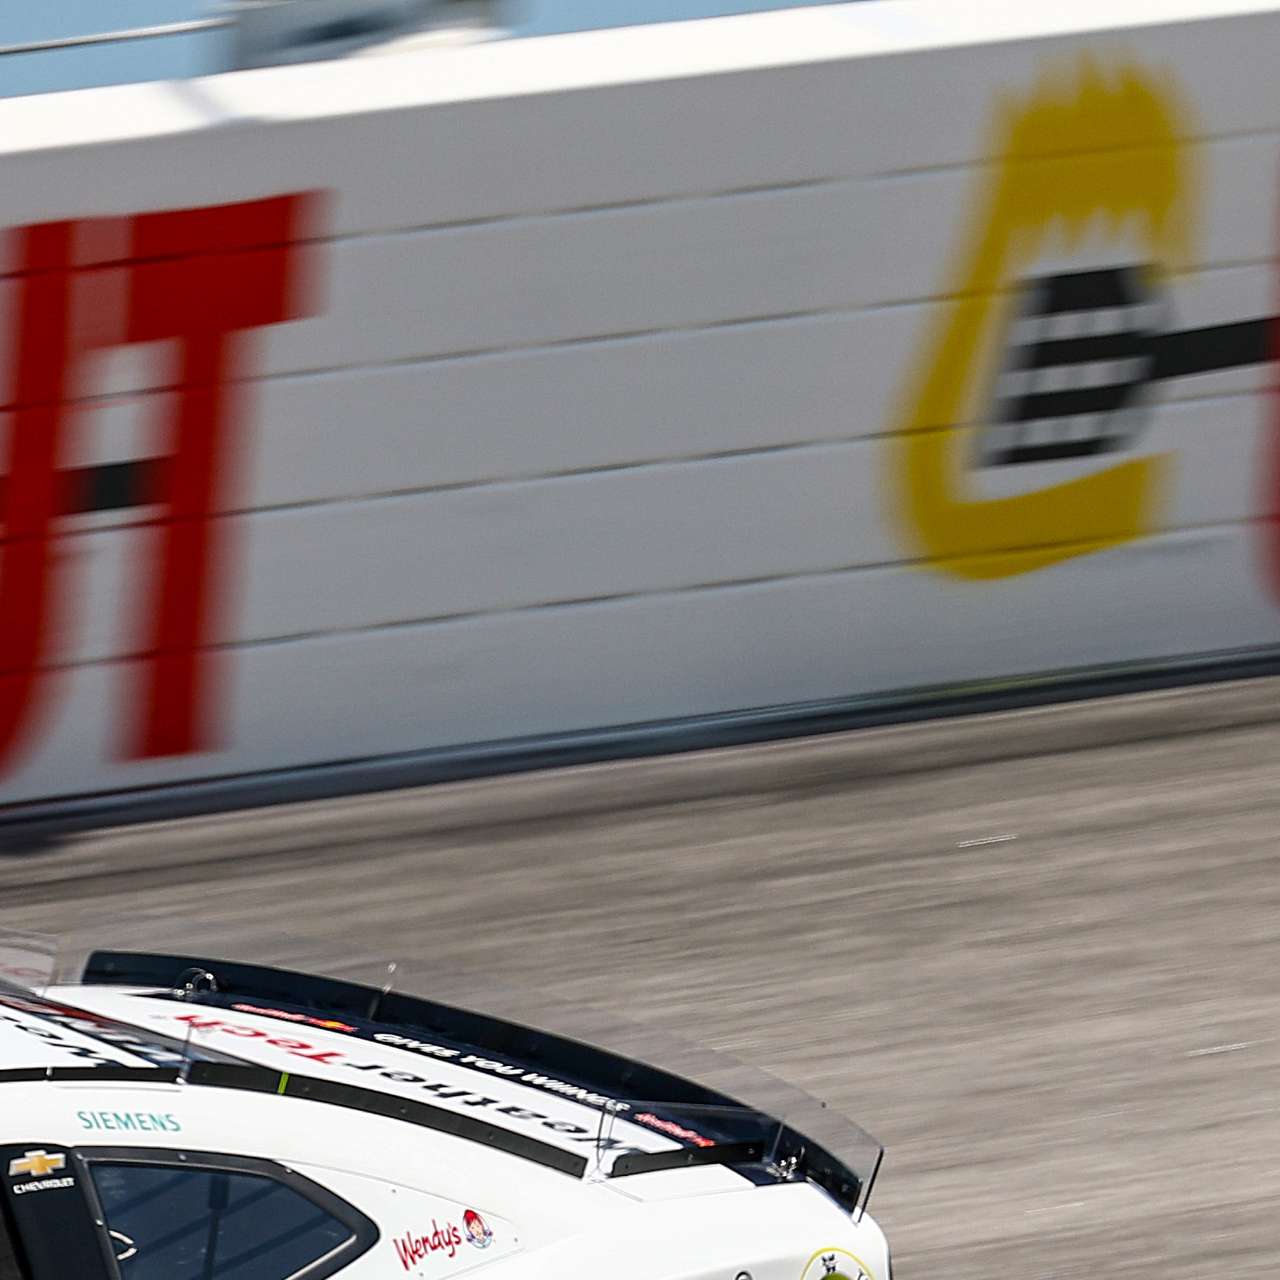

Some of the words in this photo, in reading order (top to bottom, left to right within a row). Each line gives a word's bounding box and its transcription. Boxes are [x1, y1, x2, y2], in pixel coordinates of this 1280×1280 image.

[77, 1111, 181, 1131] SIEMENS
[13, 1177, 75, 1194] CHEVROLET
[392, 1218, 462, 1271] Wendy's
